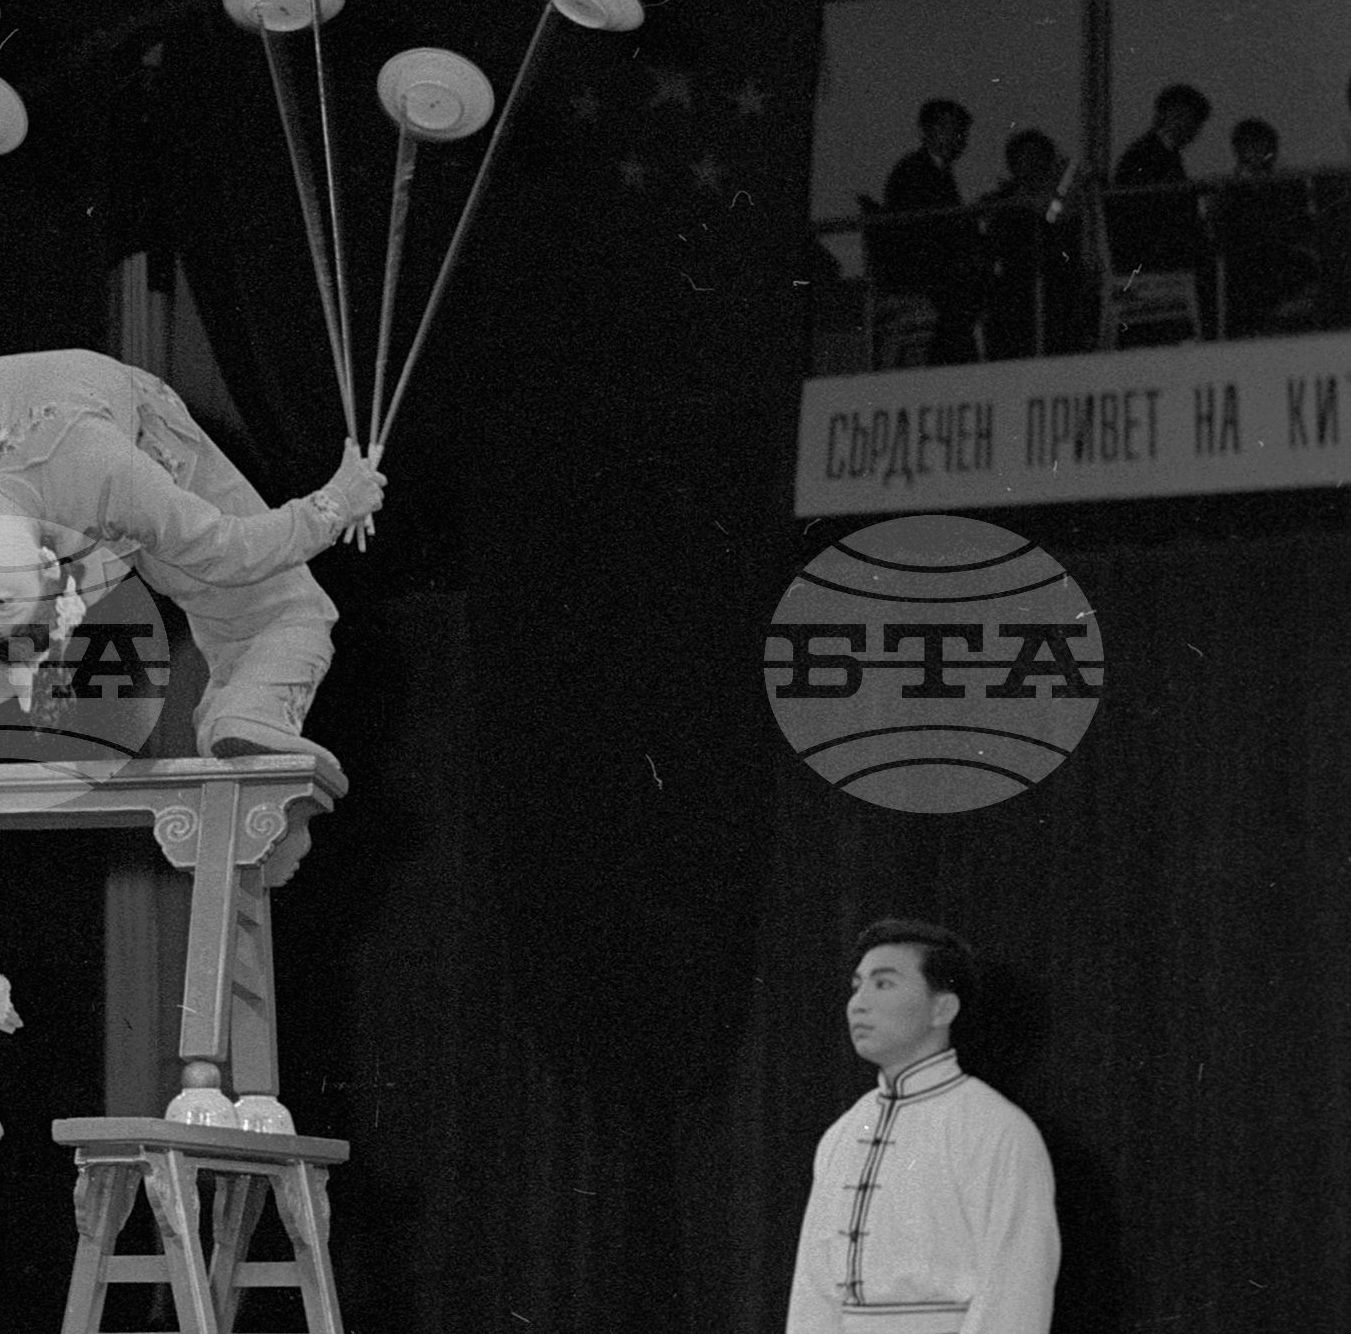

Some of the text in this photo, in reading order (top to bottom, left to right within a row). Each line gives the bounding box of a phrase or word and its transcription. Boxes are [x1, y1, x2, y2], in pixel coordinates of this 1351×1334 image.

[1026, 390, 1160, 467] ПРИВЕТ
[1193, 378, 1242, 458] НА
[1285, 370, 1351, 449] КИ
